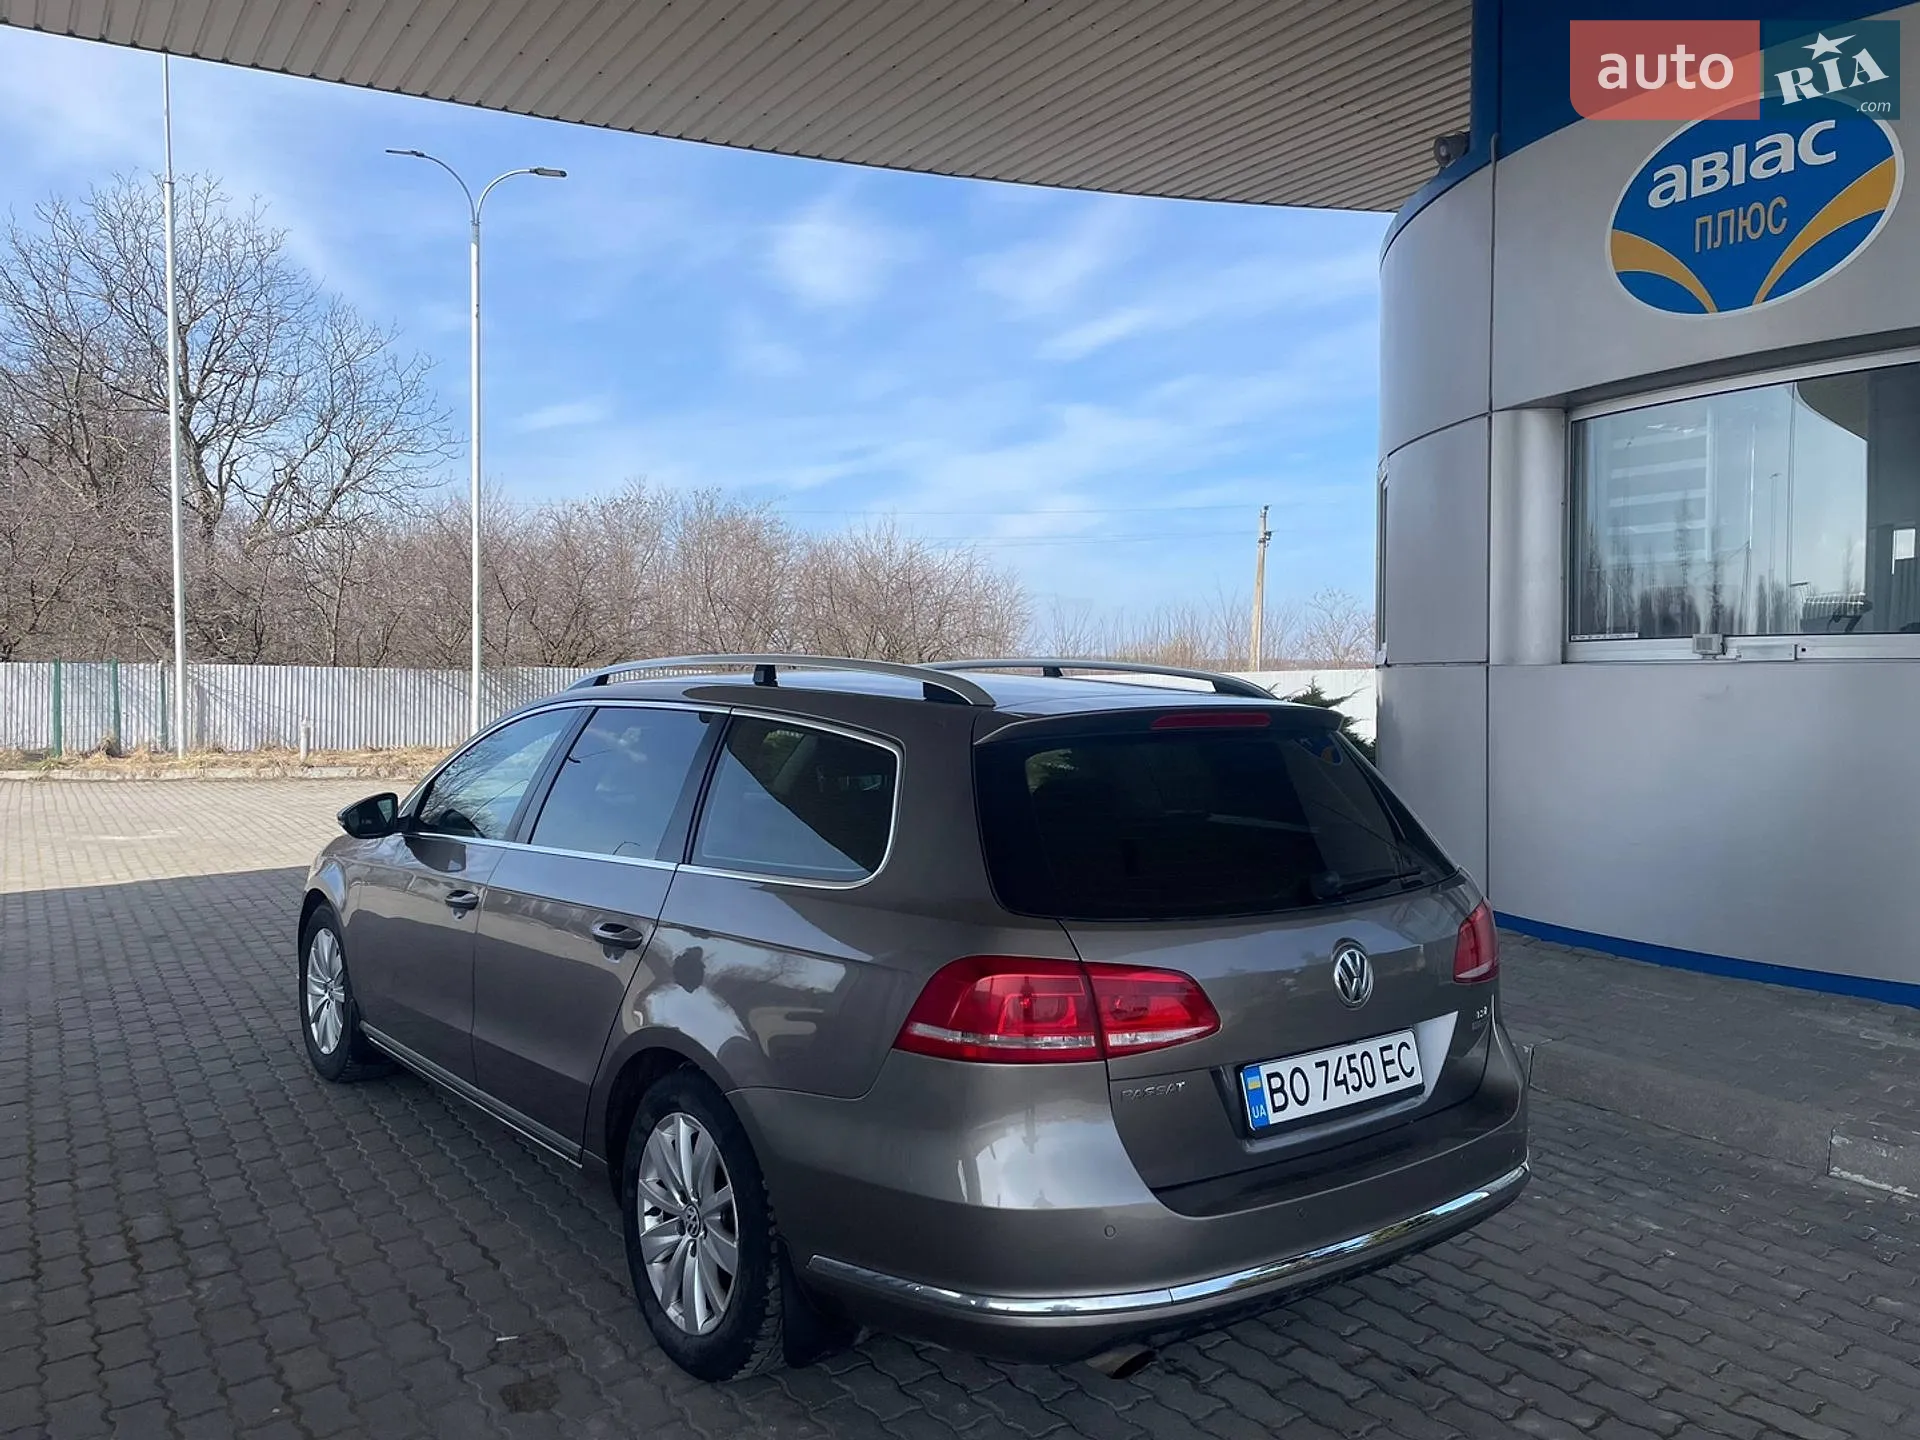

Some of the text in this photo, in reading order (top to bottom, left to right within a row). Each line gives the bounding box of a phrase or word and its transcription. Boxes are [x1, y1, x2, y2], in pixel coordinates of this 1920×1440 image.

[1695, 196, 1788, 253] ПЛЮС
[1266, 1041, 1415, 1114] BO 7450 EC
[1251, 1105, 1267, 1119] UA
